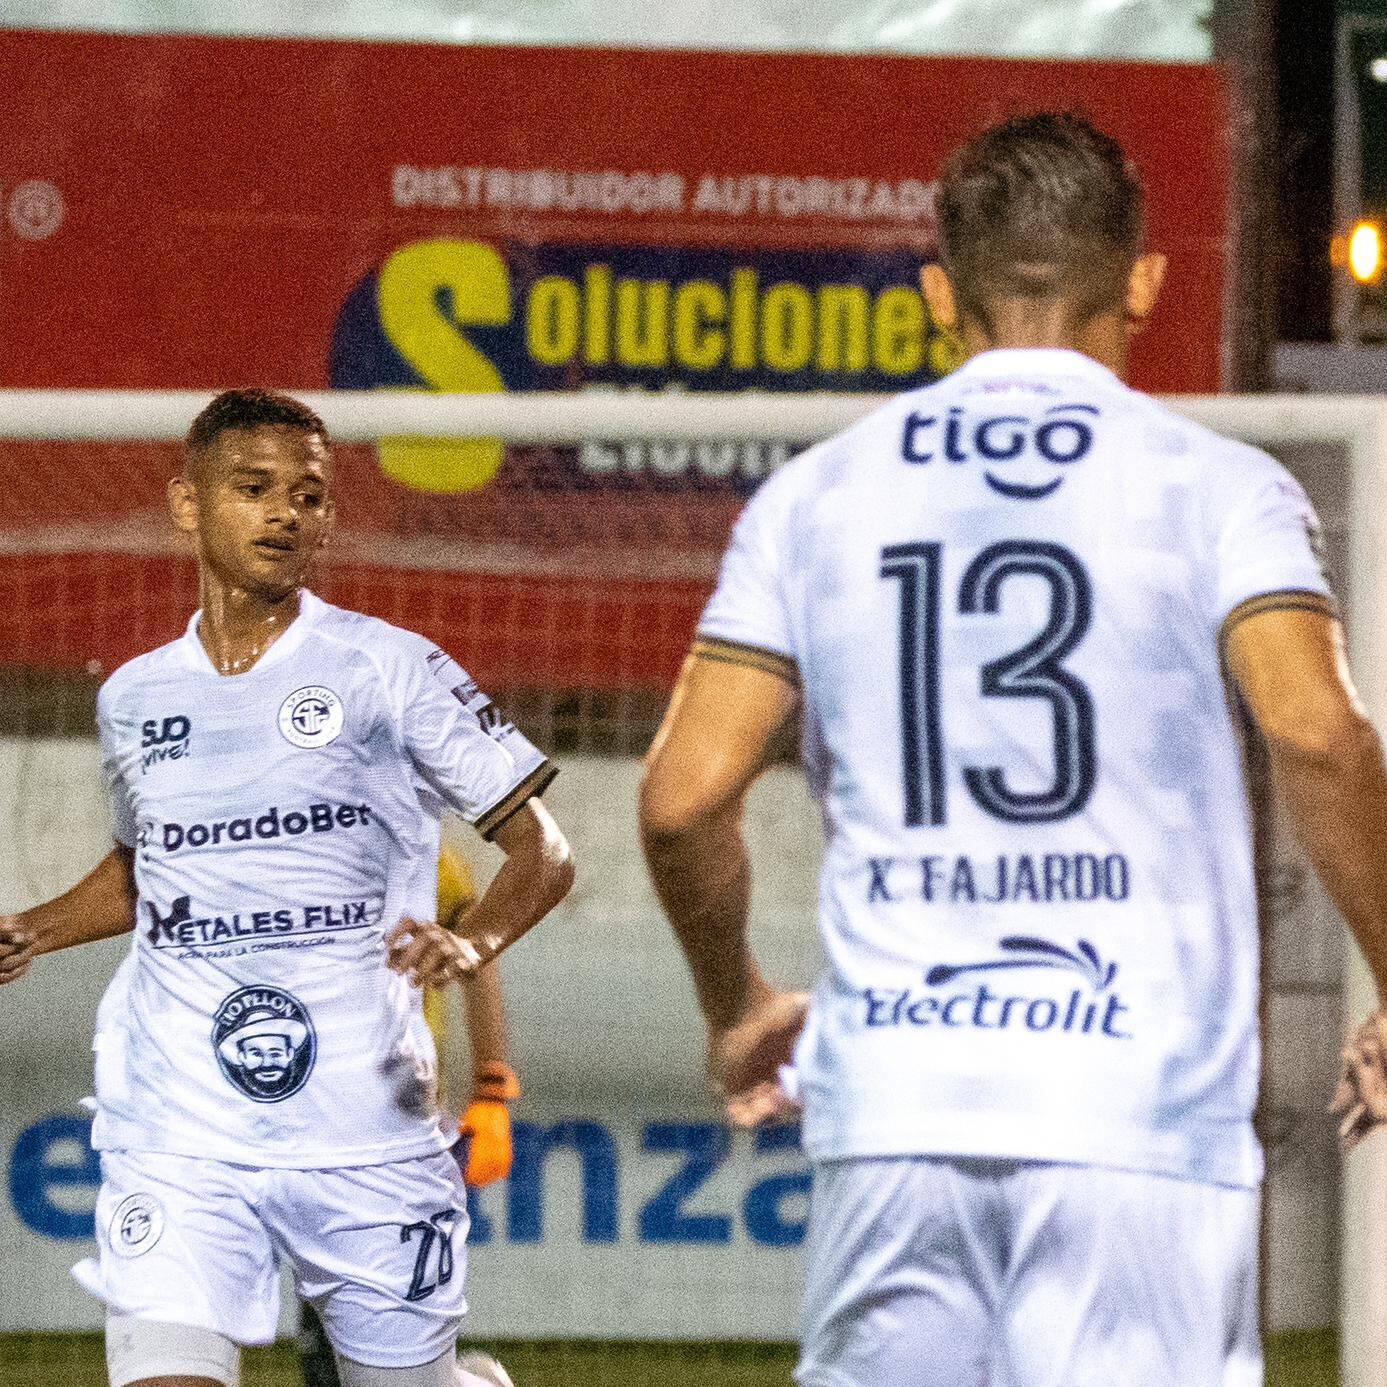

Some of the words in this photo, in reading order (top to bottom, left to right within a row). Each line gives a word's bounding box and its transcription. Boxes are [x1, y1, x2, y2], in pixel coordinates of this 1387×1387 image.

[393, 164, 684, 214] DISTRIBUIDOR
[899, 403, 1100, 464] tigo
[877, 538, 1099, 829] 13
[163, 802, 371, 852] DoradoBet
[922, 853, 1130, 903] FAJARDO
[147, 895, 294, 946] METALES
[303, 901, 367, 929] FLIX
[862, 984, 1133, 1039] Electrolit
